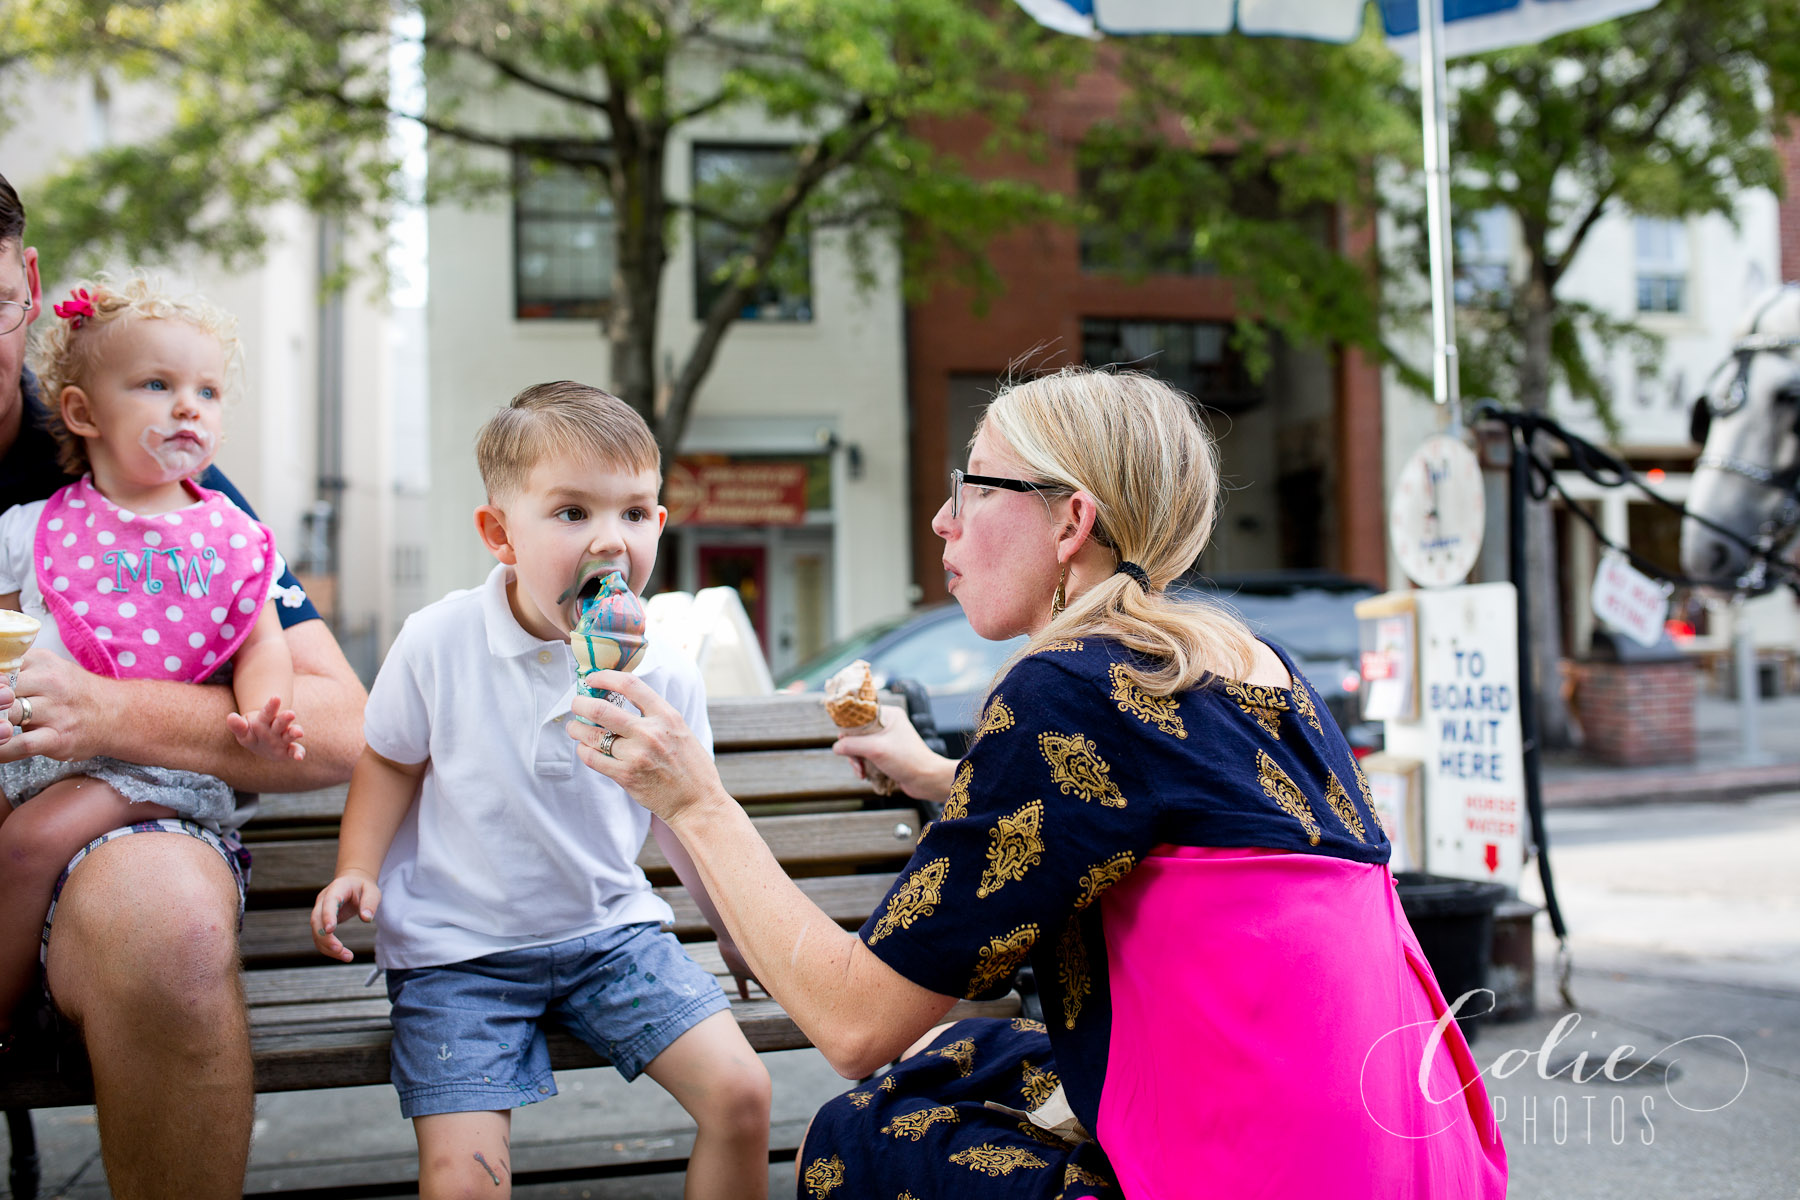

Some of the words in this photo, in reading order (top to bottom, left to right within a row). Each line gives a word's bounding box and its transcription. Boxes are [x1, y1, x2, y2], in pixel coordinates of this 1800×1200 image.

[1453, 650, 1486, 678] TO
[1430, 683, 1512, 713] BOARD
[1440, 718, 1501, 746] WAIT
[1439, 751, 1504, 782] HERE
